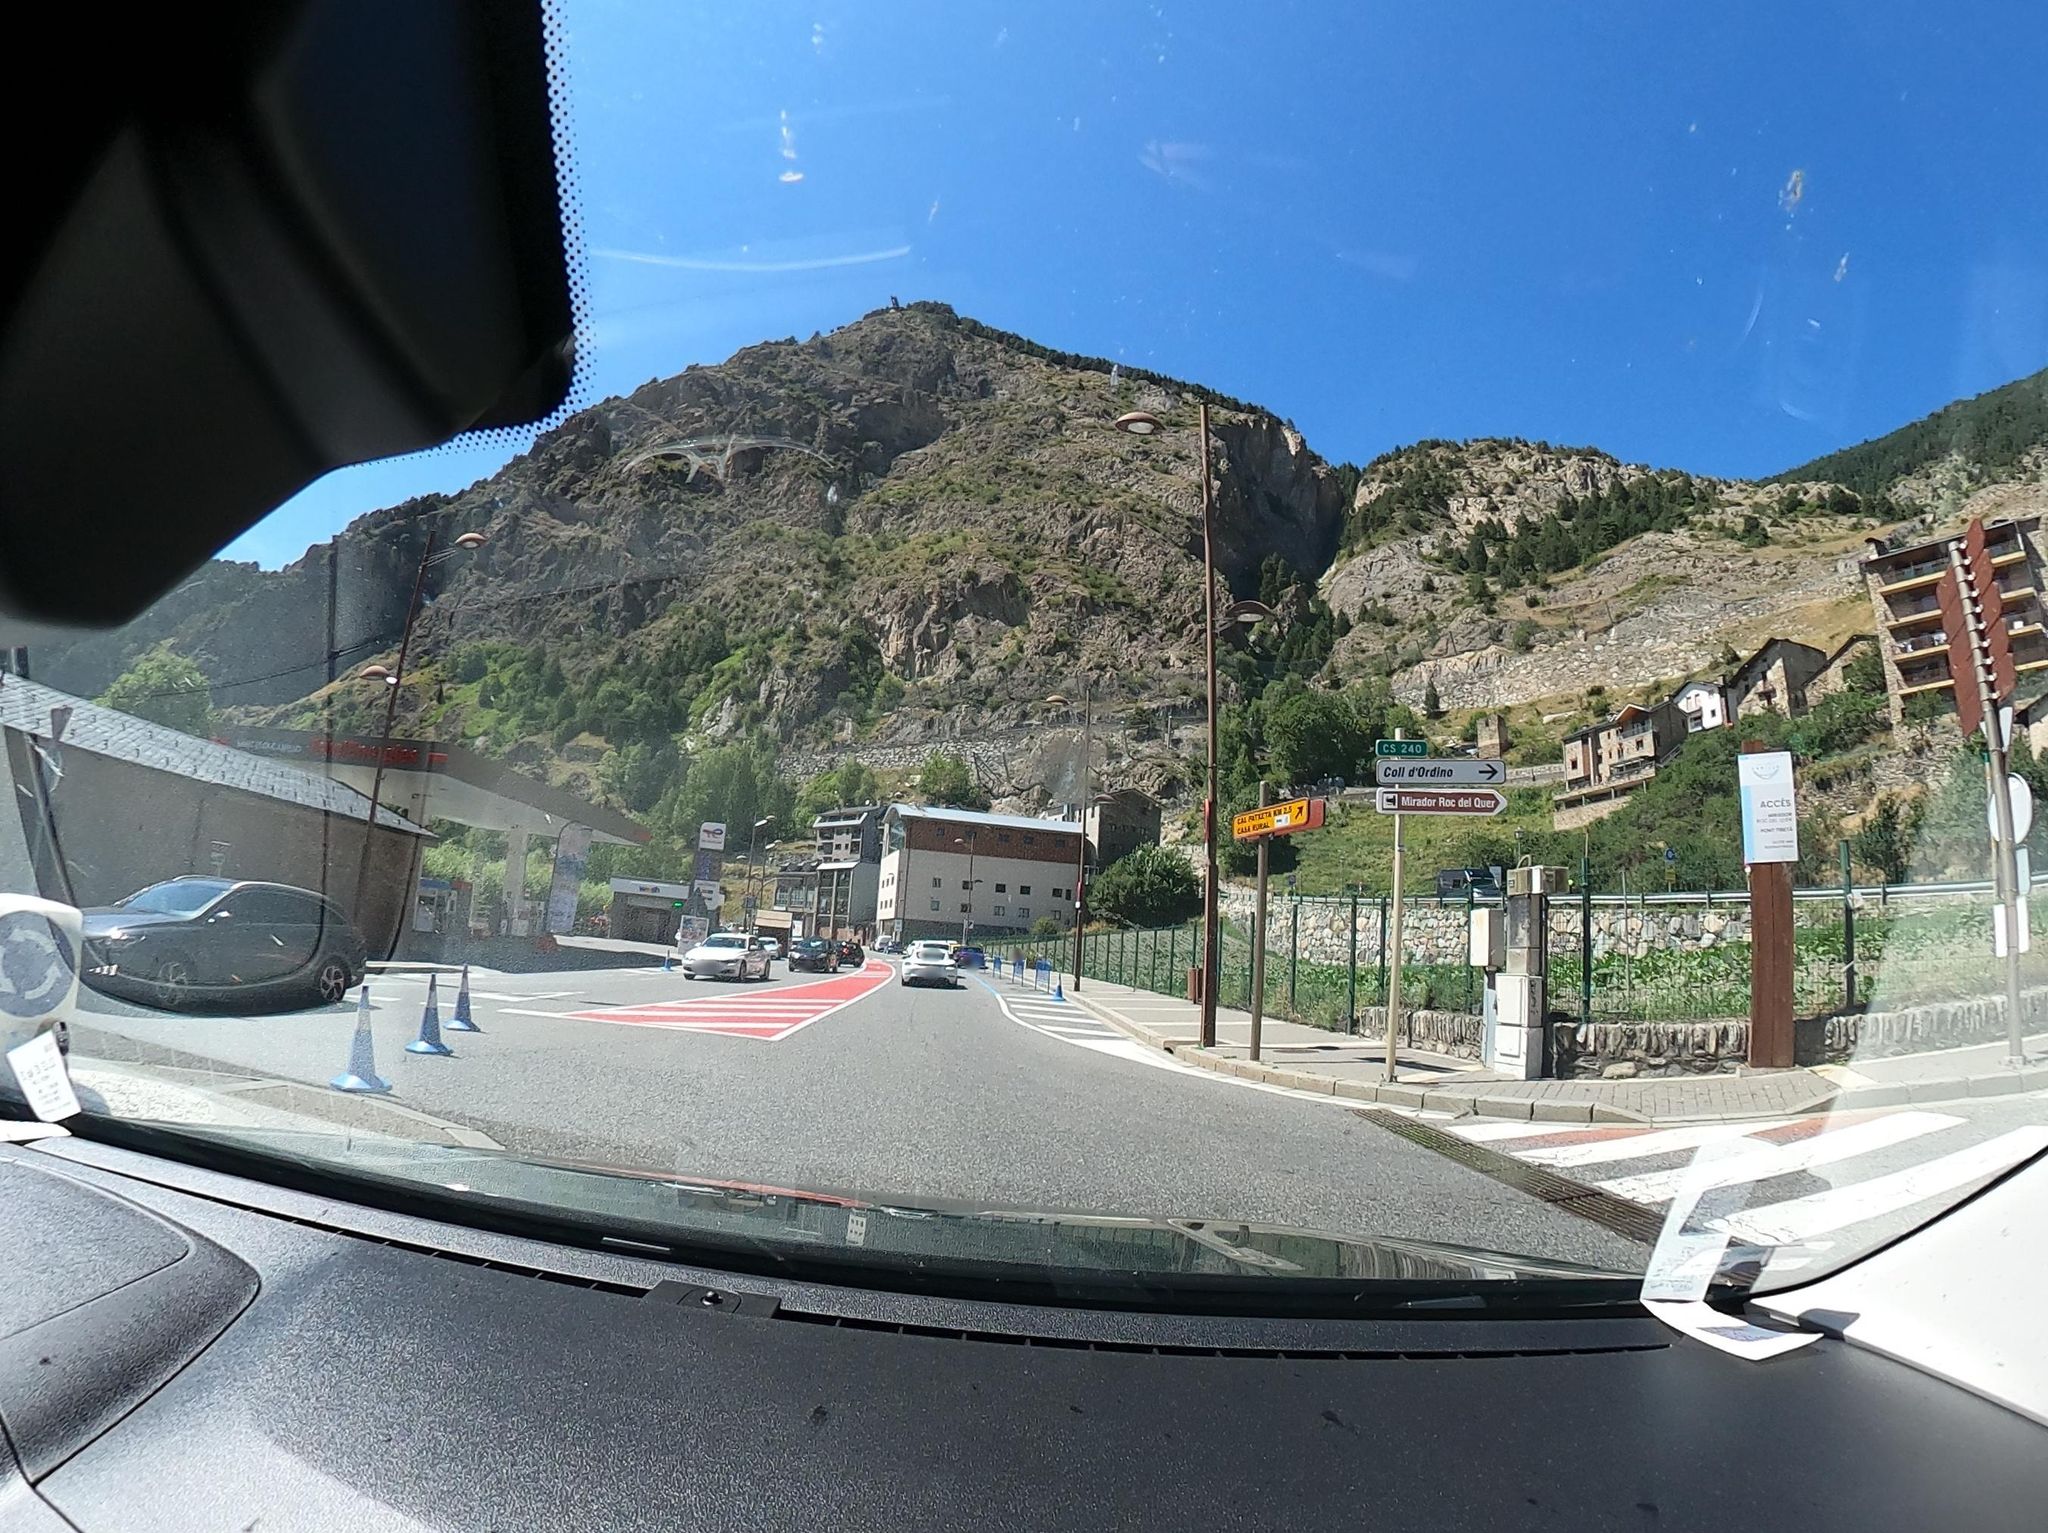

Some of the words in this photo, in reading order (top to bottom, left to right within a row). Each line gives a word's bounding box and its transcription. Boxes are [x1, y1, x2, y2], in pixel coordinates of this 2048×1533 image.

[1382, 744, 1396, 753] CS
[1400, 744, 1422, 753] 240
[1383, 766, 1405, 778] Coll
[1408, 766, 1454, 778] d'Ordino
[1401, 796, 1437, 807] Mirador
[1438, 797, 1456, 808] Roc
[1458, 797, 1472, 808] del
[1474, 798, 1496, 809] Quer
